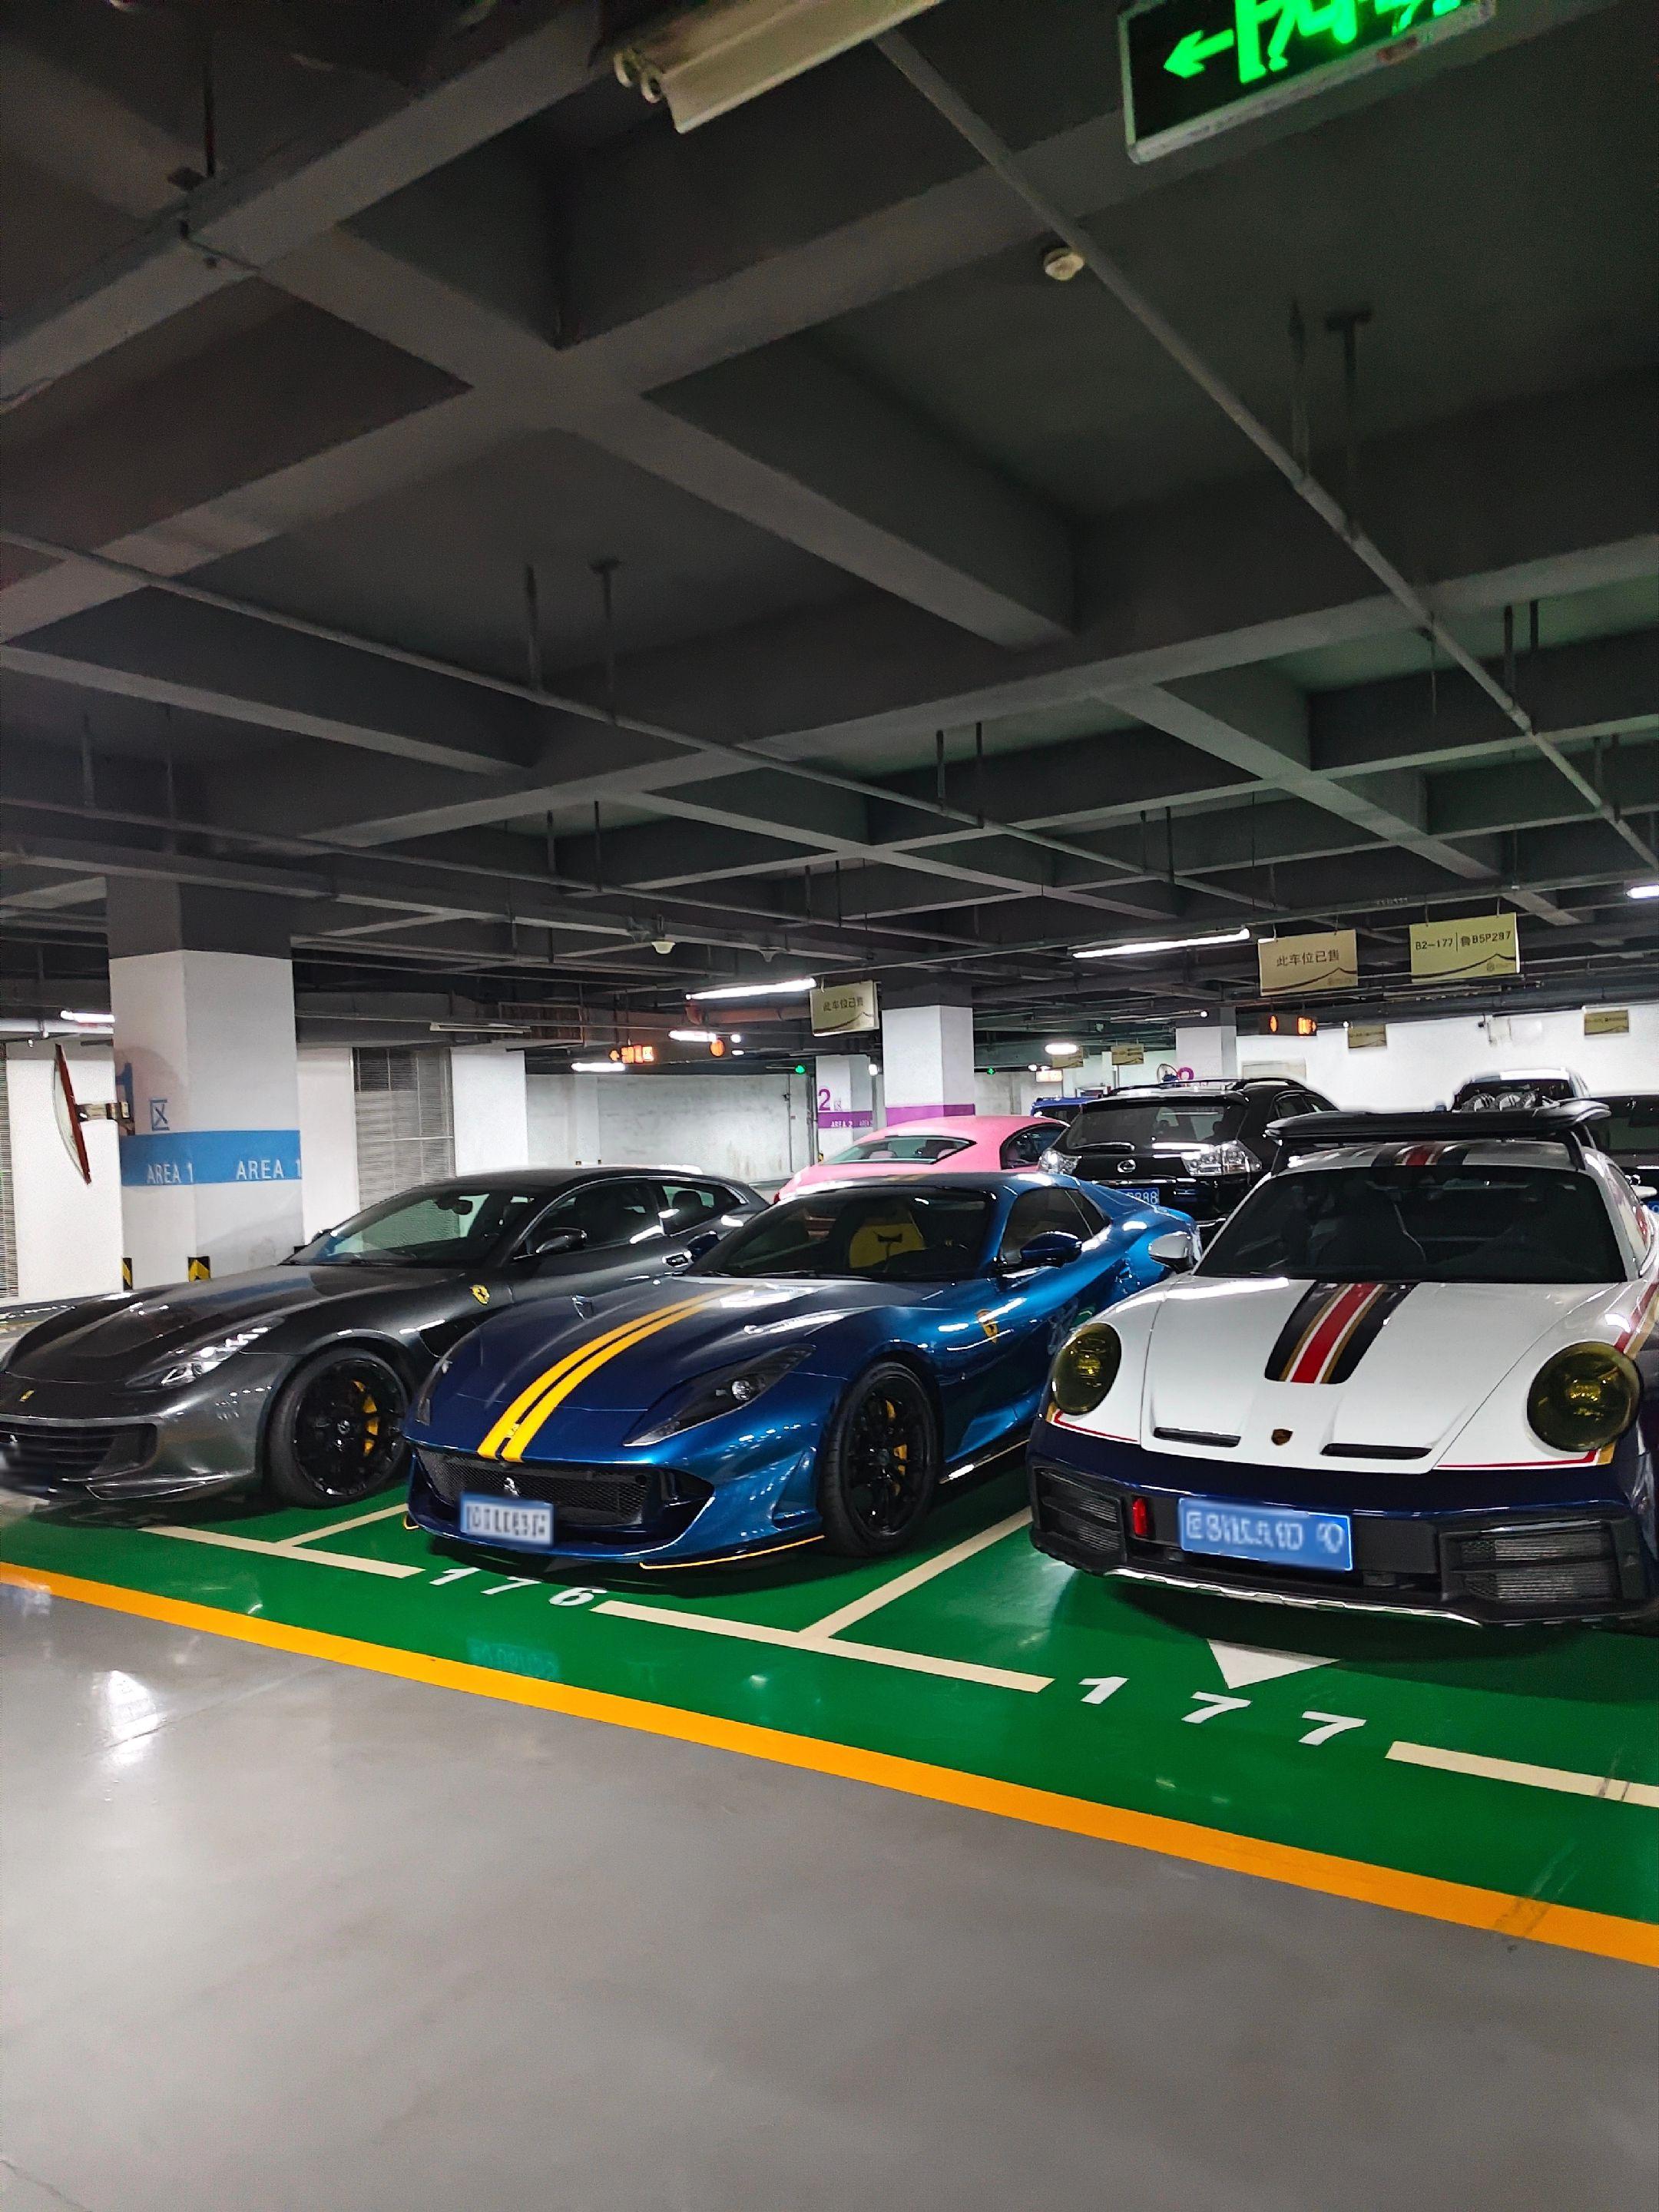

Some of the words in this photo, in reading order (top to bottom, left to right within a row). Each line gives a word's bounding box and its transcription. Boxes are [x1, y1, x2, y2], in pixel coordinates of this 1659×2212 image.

[1416, 938, 1453, 950] B2-177
[1276, 949, 1339, 967] 此车位已售
[147, 1163, 180, 1184] AREA
[187, 1162, 194, 1183] 1
[236, 1159, 284, 1181] AREA
